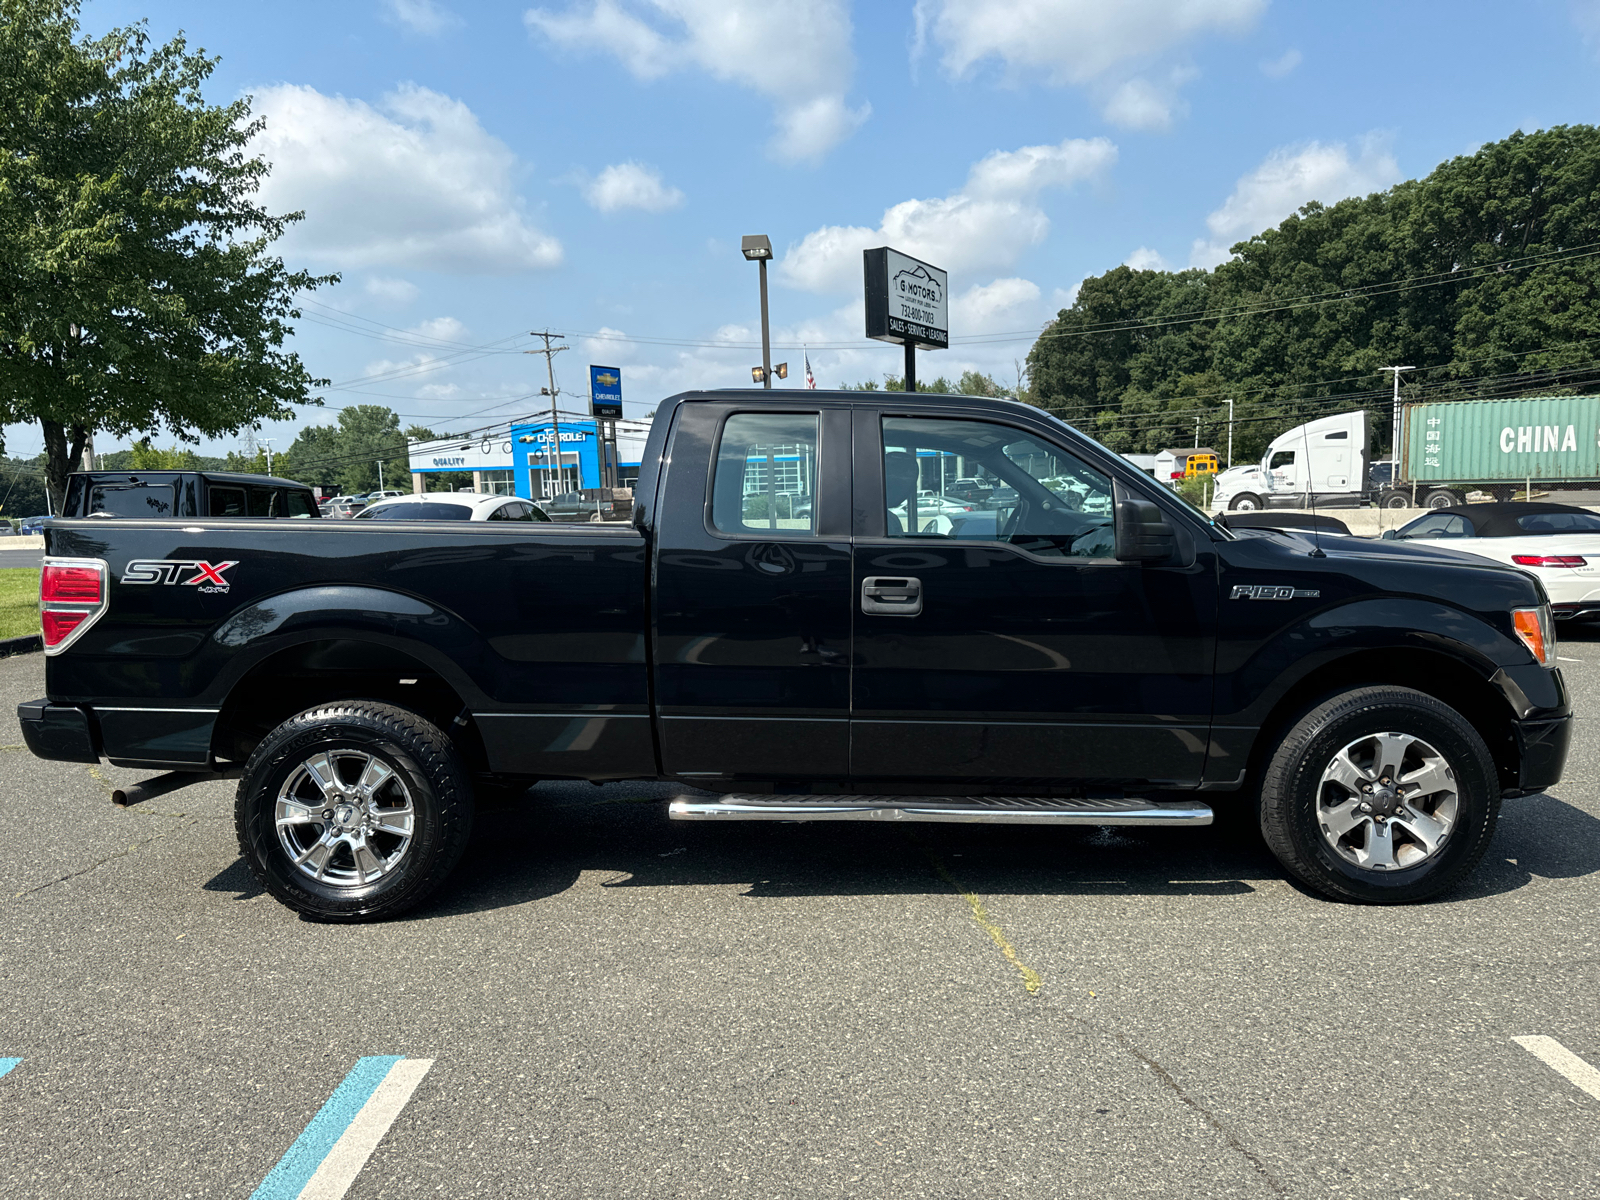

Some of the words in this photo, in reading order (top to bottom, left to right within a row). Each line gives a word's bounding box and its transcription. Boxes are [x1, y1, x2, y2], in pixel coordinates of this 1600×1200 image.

[908, 282, 935, 301] MOTORS
[901, 304, 934, 324] 732-800-7003
[890, 319, 904, 332] SALES
[908, 324, 926, 337] SERVICE
[929, 329, 946, 342] LEASING
[595, 393, 621, 401] CHEVROLET
[537, 432, 586, 443] CHEROLET
[1500, 425, 1577, 453] CHINA
[432, 457, 465, 467] QUALITY
[120, 559, 240, 586] STX
